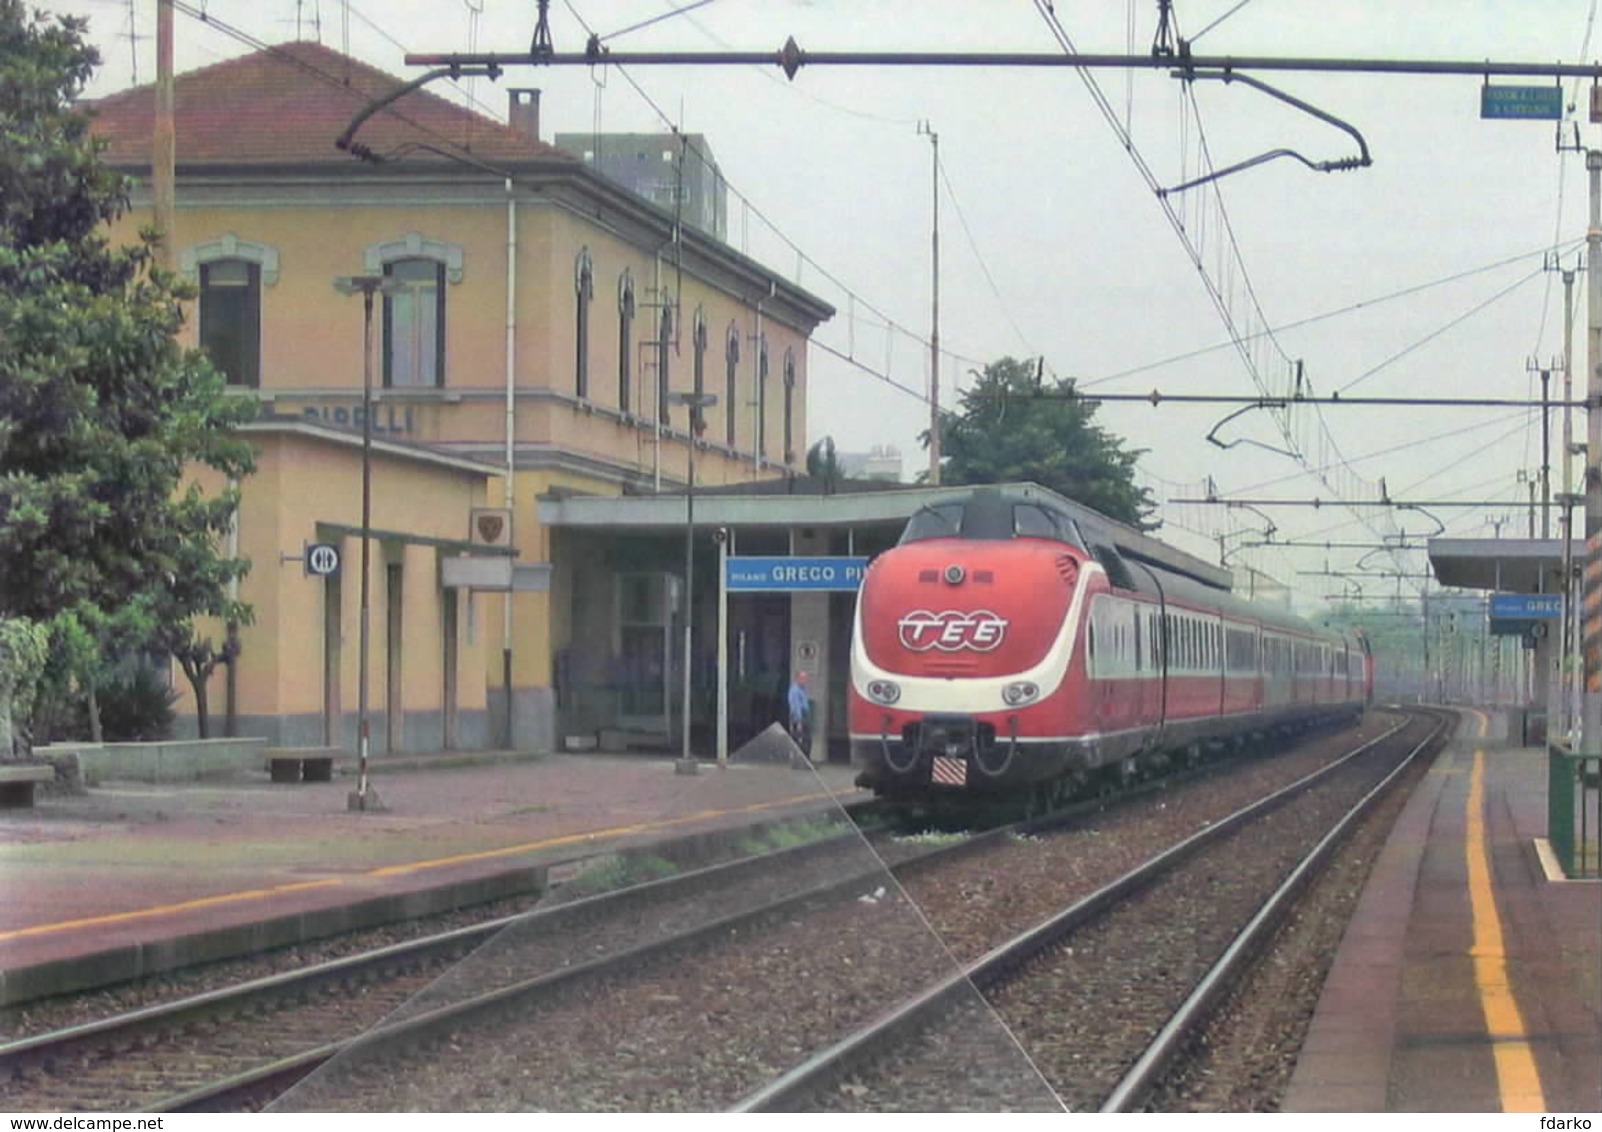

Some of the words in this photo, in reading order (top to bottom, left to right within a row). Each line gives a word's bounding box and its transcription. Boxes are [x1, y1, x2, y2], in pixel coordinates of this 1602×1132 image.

[772, 566, 835, 581] GRECO
[1527, 601, 1561, 612] GREC
[898, 618, 1007, 642] TEE
